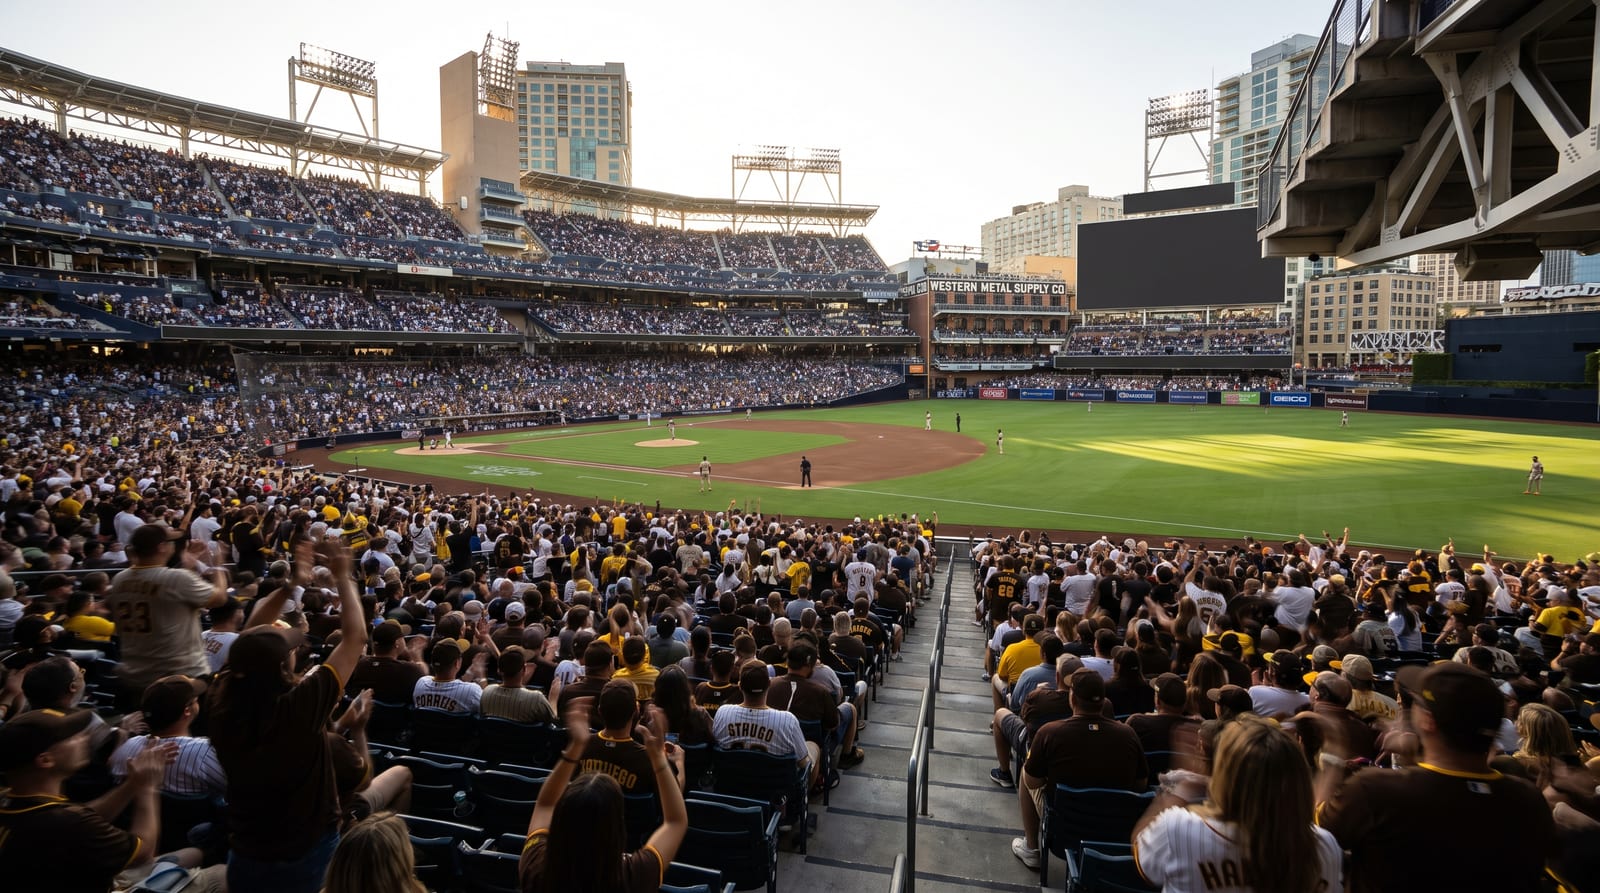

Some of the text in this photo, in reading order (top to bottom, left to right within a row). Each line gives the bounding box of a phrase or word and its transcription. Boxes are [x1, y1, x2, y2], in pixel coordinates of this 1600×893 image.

[930, 280, 979, 292] WESTERN
[981, 281, 1011, 293] METAL
[1014, 283, 1050, 294] SUPPLY
[1052, 284, 1065, 295] CO
[859, 575, 866, 587] 8
[728, 722, 774, 743] STRUGO
